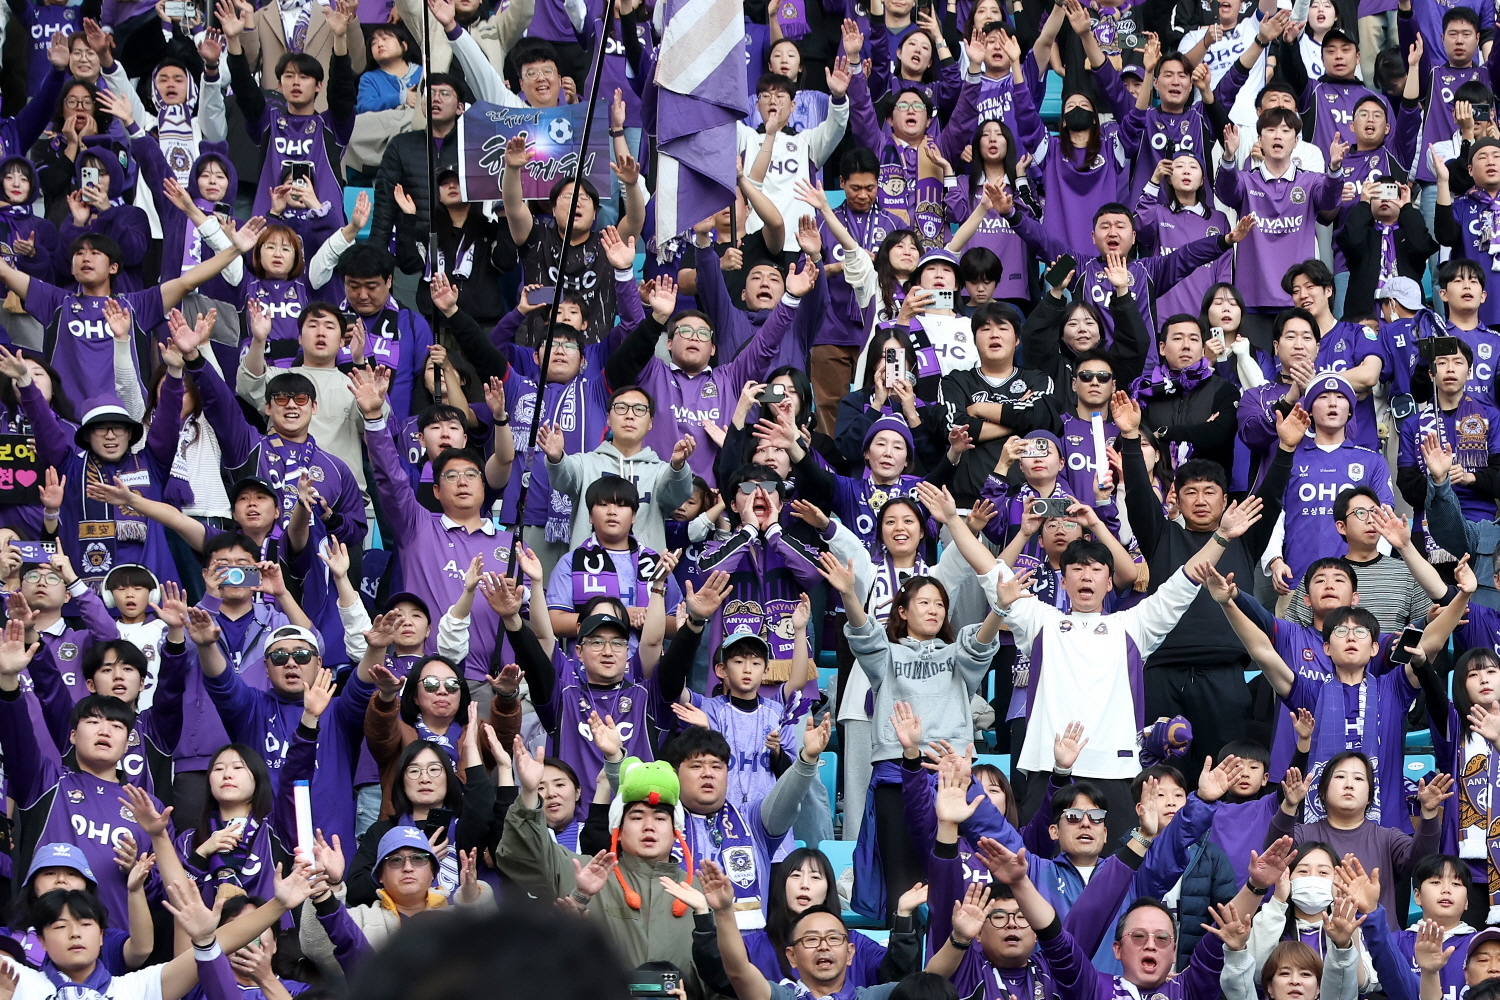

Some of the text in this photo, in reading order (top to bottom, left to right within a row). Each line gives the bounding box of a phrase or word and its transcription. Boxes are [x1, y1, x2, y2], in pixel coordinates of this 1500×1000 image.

[1330, 108, 1354, 124] OH
[275, 137, 313, 155] OHC
[768, 158, 799, 175] HC
[917, 215, 941, 224] ANYANG
[933, 344, 967, 359] HC
[1068, 452, 1097, 472] OH
[1302, 506, 1334, 516] 오상헬스
[726, 617, 762, 626] ANYANG
[578, 721, 633, 742] OC
